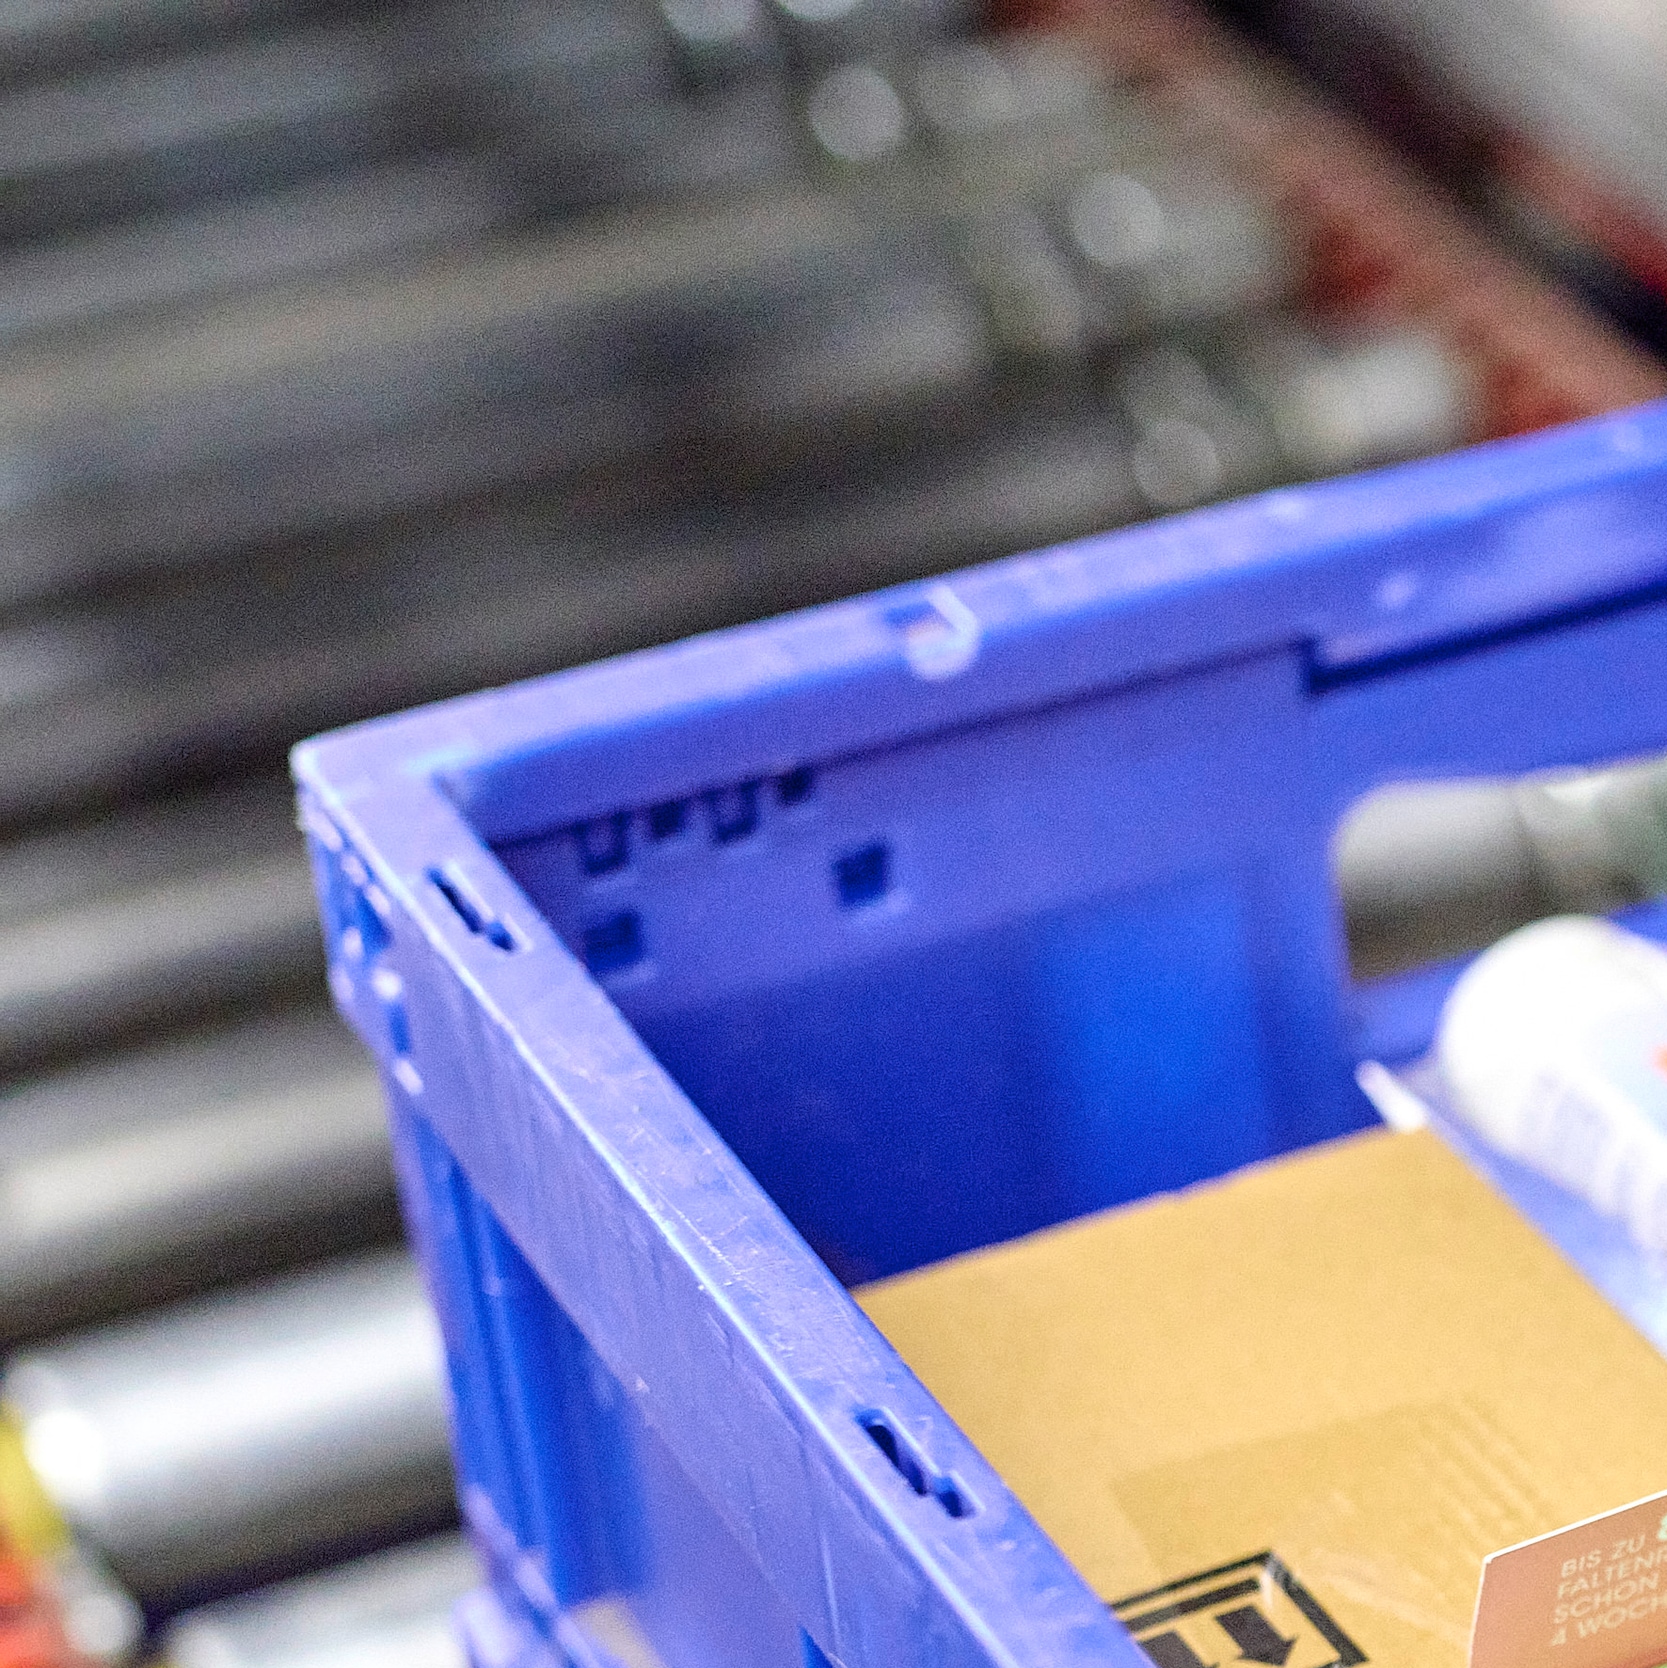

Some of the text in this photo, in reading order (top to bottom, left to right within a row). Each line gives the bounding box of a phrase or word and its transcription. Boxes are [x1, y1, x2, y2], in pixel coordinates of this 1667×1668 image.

[1561, 1550, 1601, 1577] BIS
[1612, 1534, 1646, 1560] ZU
[1554, 1572, 1659, 1624] SCHON
[1551, 1627, 1568, 1646] 4
